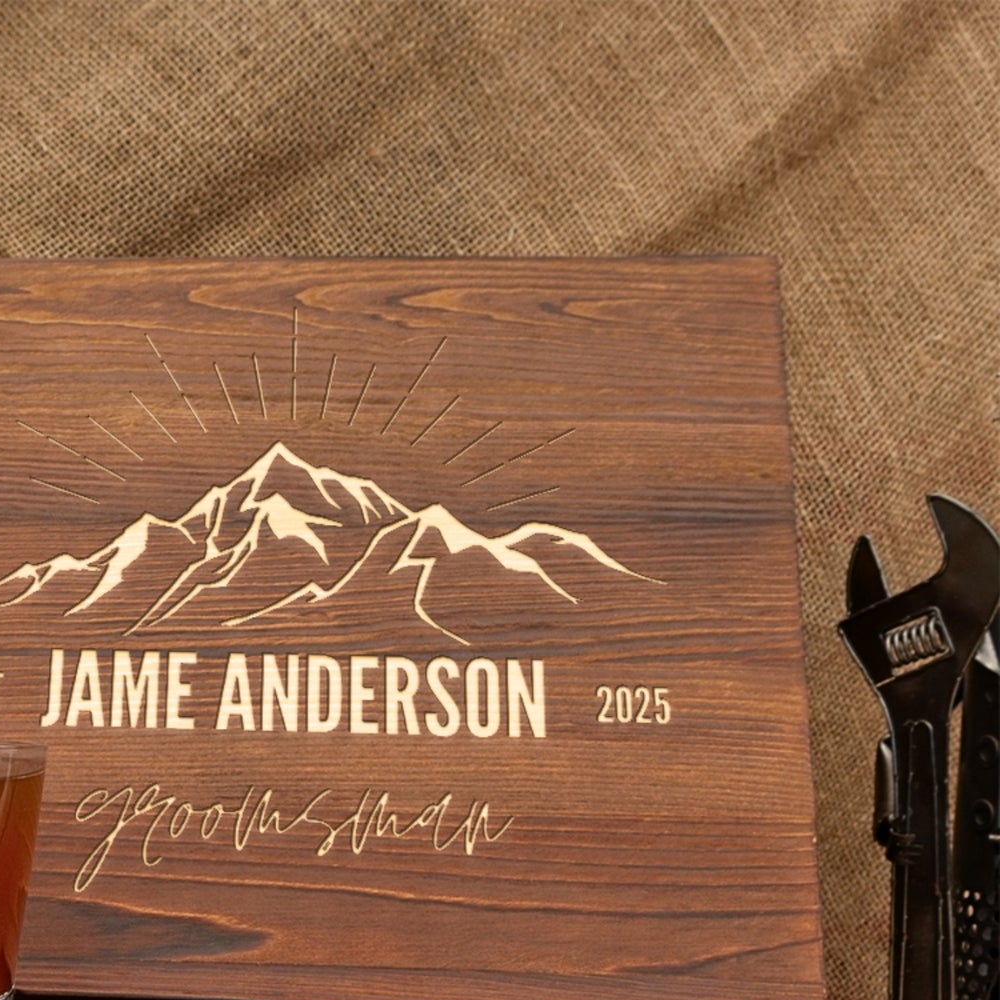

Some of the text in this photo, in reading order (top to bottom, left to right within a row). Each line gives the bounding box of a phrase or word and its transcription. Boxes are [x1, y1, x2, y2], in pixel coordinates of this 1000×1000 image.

[40, 647, 200, 729] JAME
[214, 652, 548, 739] ANDERSON
[596, 686, 671, 725] 2025
